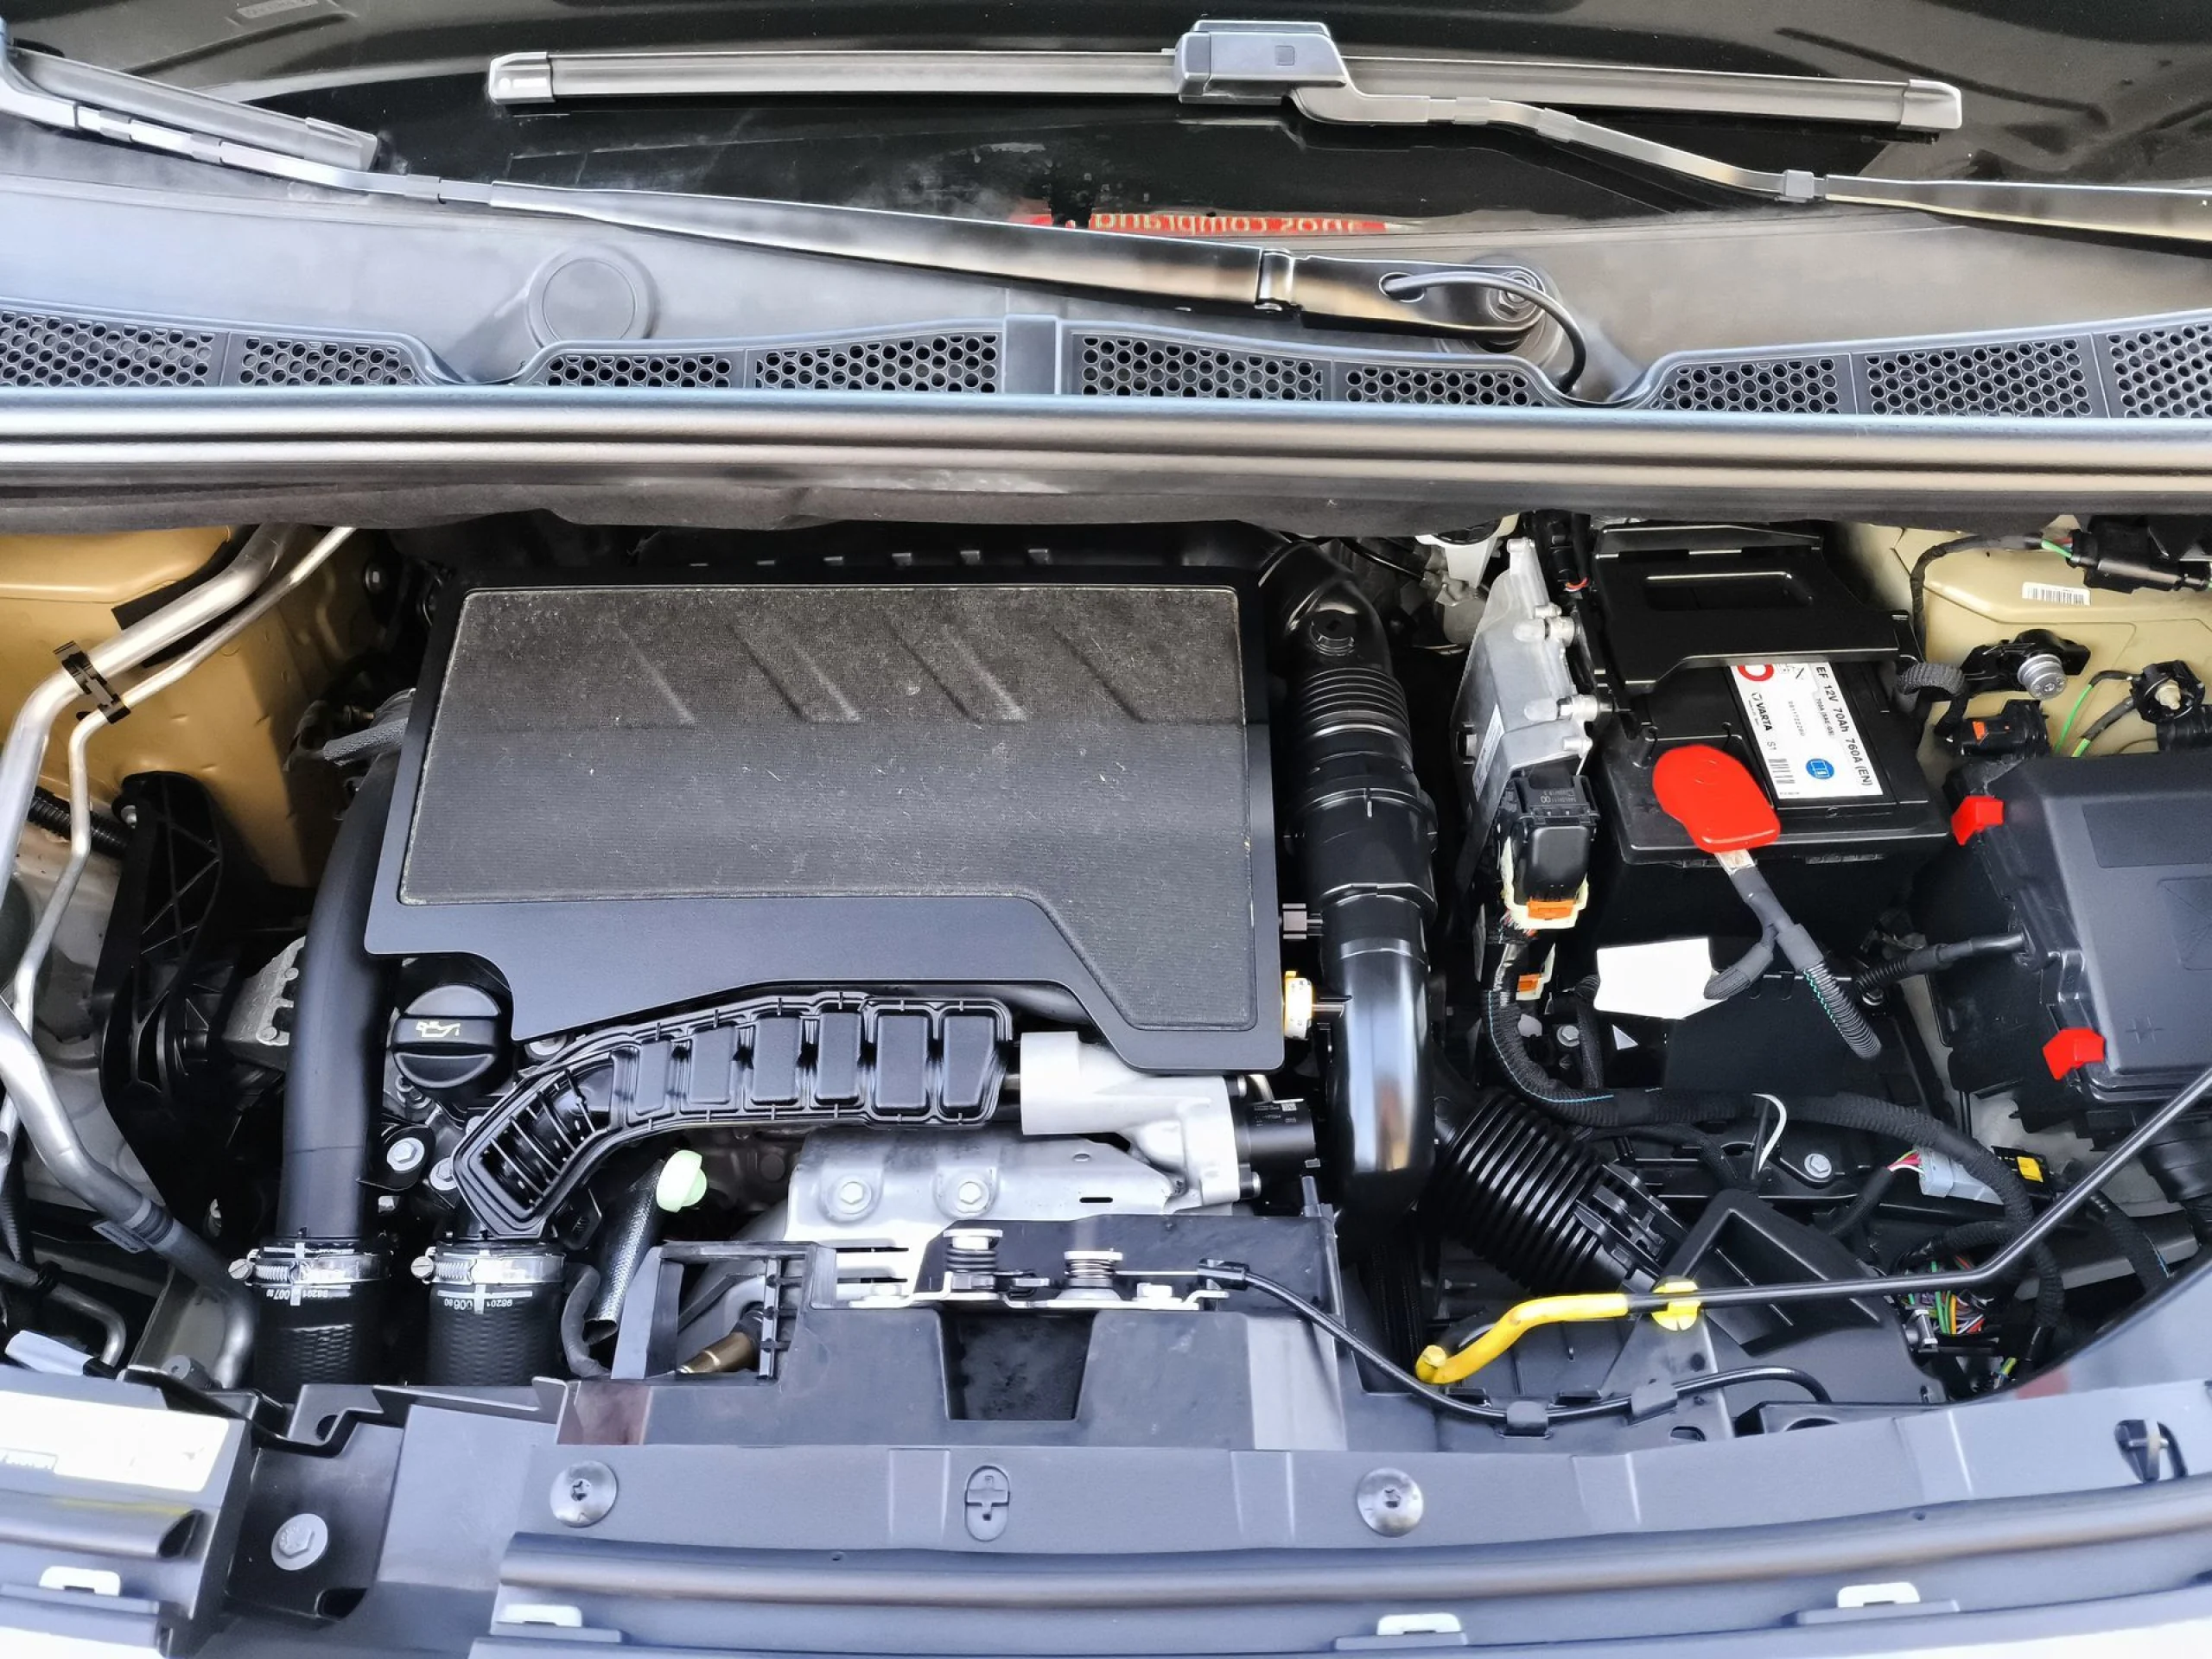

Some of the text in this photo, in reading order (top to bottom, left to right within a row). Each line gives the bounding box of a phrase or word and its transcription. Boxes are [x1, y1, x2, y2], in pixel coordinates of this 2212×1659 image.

[1756, 702, 1773, 731] VARTA
[1824, 684, 1839, 702] 12V
[1833, 707, 1850, 732] 70Ah
[1846, 738, 1863, 764] 760A
[1855, 764, 1873, 786] (EN)
